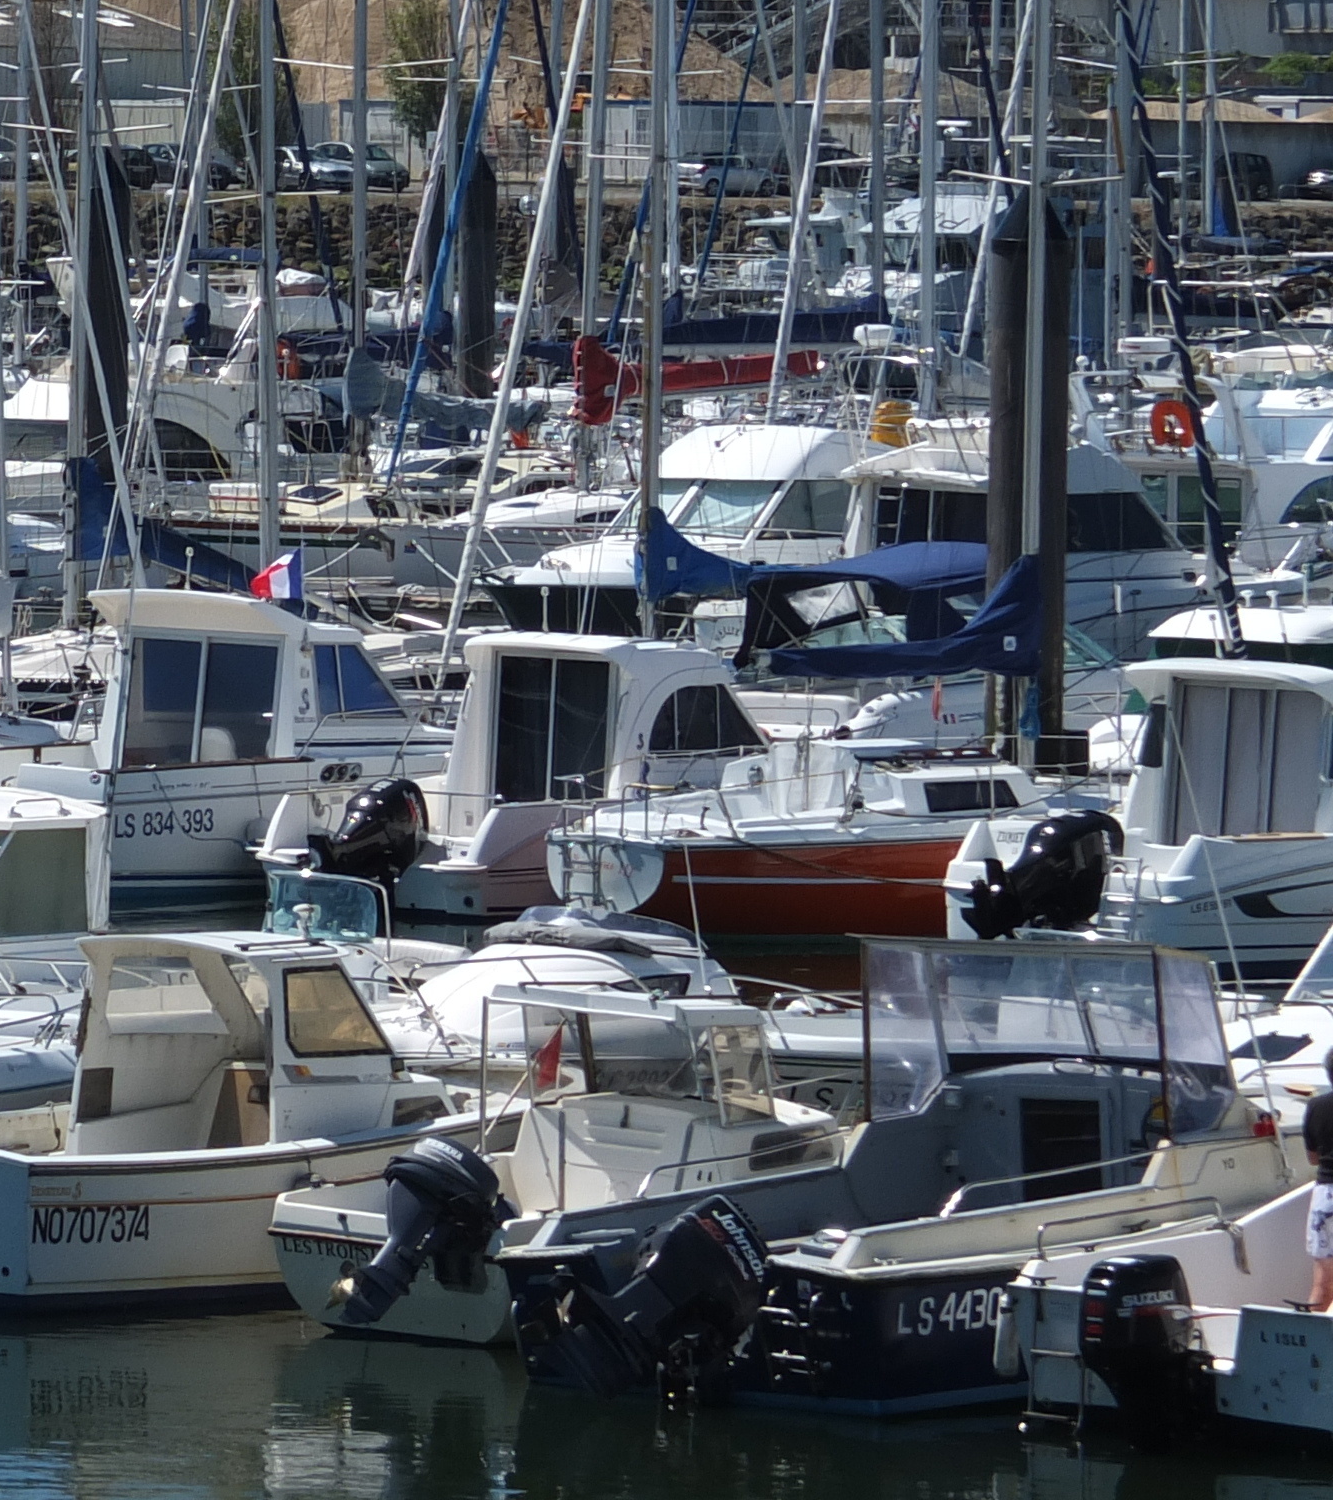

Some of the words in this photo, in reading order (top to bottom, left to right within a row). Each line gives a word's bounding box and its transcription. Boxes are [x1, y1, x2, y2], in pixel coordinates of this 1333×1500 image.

[114, 813, 135, 839] LS
[142, 811, 174, 836] 834
[182, 808, 214, 834] 393
[282, 1237, 312, 1254] LES
[711, 1210, 764, 1283] Johnson
[897, 1297, 935, 1336] LS
[938, 1286, 1003, 1332] 4430
[1121, 1289, 1175, 1307] SUZUKI
